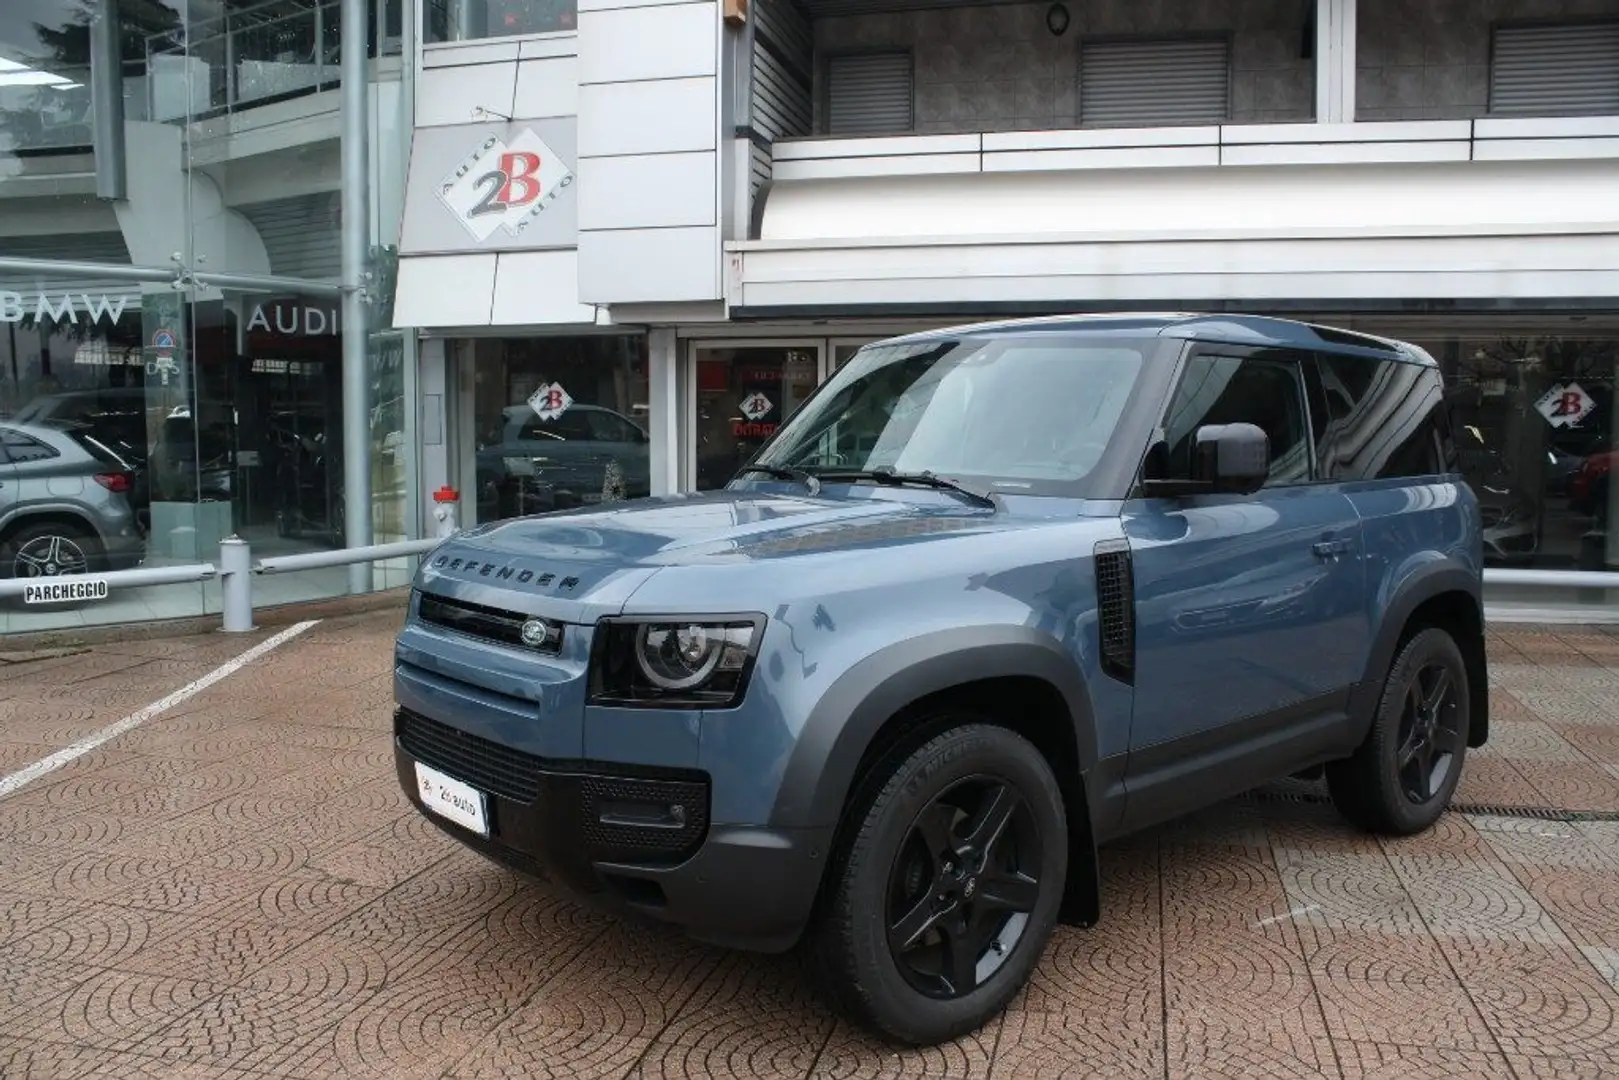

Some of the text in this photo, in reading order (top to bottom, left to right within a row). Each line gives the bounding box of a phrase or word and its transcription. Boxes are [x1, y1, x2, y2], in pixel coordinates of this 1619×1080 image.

[442, 137, 497, 196] AUTO
[466, 151, 542, 220] 2B
[516, 174, 574, 235] AUTO
[0, 291, 127, 326] BMW
[246, 304, 338, 336] AUDI
[540, 389, 564, 412] 2B
[1549, 391, 1583, 418] 2B
[26, 581, 106, 601] PARCHEGGIO
[434, 555, 580, 592] DEFENDER
